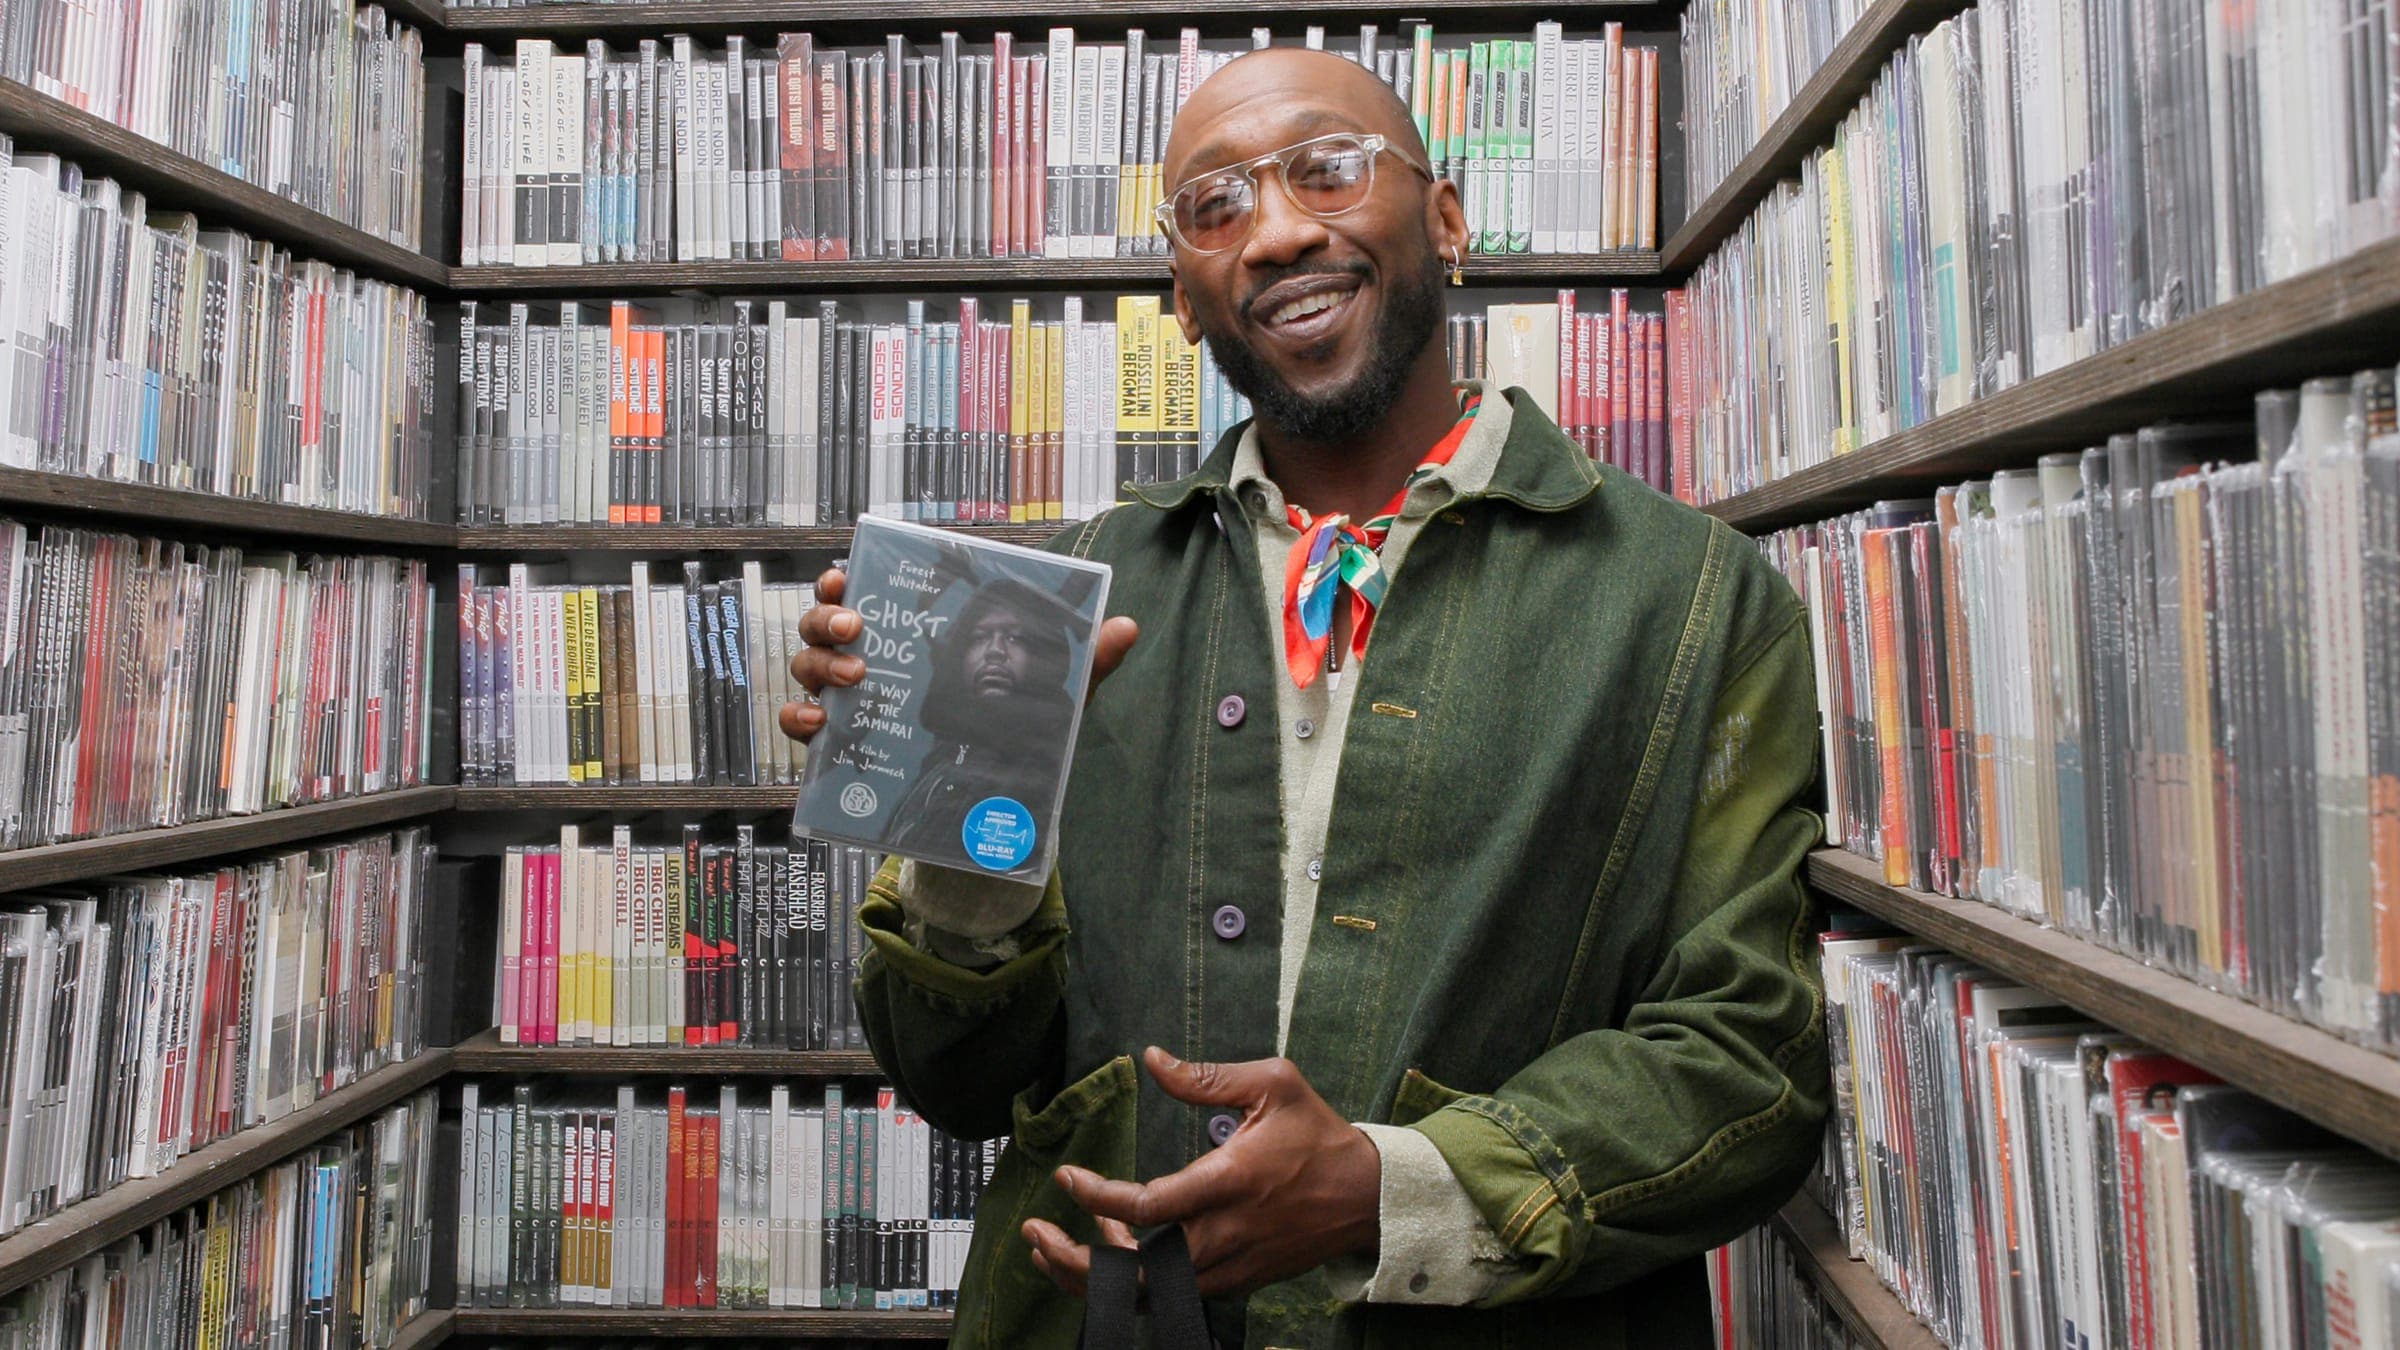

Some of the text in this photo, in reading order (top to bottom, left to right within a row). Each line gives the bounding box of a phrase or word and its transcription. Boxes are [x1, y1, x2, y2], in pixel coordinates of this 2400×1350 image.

[468, 60, 478, 165] Sunday Bloody Sunday
[521, 52, 532, 164] TRILOGY OF LIFE
[675, 61, 687, 156] PURPLE NOON
[695, 72, 706, 166] PURPLE NOON
[787, 58, 802, 145] THE QATSI TRILOGY
[821, 64, 836, 151] THE QATSI TRILOGY
[1052, 40, 1067, 137] ON THE WATERFRONT
[1078, 58, 1093, 156] ON THE WATERFRONT
[512, 315, 522, 394] medium cool
[529, 340, 539, 418] medium cool
[563, 312, 573, 396] LIFE IS SWEET
[874, 341, 885, 420] SECONDS
[891, 339, 903, 418] SECONDS
[910, 360, 919, 412] THE BIG CITY
[962, 341, 971, 394] CHARULATA
[999, 354, 1007, 408] CHARULATA
[1122, 353, 1136, 417] BERGMAN
[1137, 345, 1152, 417] ROSSELLINI
[647, 386, 661, 413] COME
[700, 358, 713, 418] SAFETY LAST!
[1164, 363, 1178, 427] BERGMAN
[1179, 354, 1194, 427] ROSSELLINI
[1223, 393, 1231, 422] Witch
[889, 574, 940, 594] Whitaker
[900, 561, 935, 579] Forest
[461, 592, 475, 628] Thief
[584, 600, 594, 611] LA
[584, 613, 595, 626] VIE
[584, 628, 595, 639] DE
[750, 617, 762, 644] Tess
[857, 595, 948, 638] GHOST
[721, 596, 745, 686] FOREIGN CORRESPONDENT
[864, 627, 915, 664] DOG
[852, 712, 912, 739] SAMURAI
[860, 700, 901, 717] OF THE
[880, 683, 911, 706] WAY
[832, 750, 904, 779] Jim Jarmusch
[859, 744, 876, 756] film
[879, 750, 890, 761] by
[978, 842, 1015, 855] BLU-RAY
[651, 866, 663, 947] BIG CHILL
[668, 860, 681, 949] LOVE STREAMS
[756, 863, 770, 938] ALL THAT JAZZ
[789, 854, 807, 929] ERASERHEAD
[810, 872, 825, 931] ERASERHEAD
[514, 1104, 525, 1211] EVERY MAN FOR HIMSELF
[564, 1126, 577, 1203] don't look now
[599, 1130, 612, 1206] don't look now
[775, 1126, 785, 1176] the soft skin
[825, 1100, 838, 1210] RIDE THE PINK HORSE
